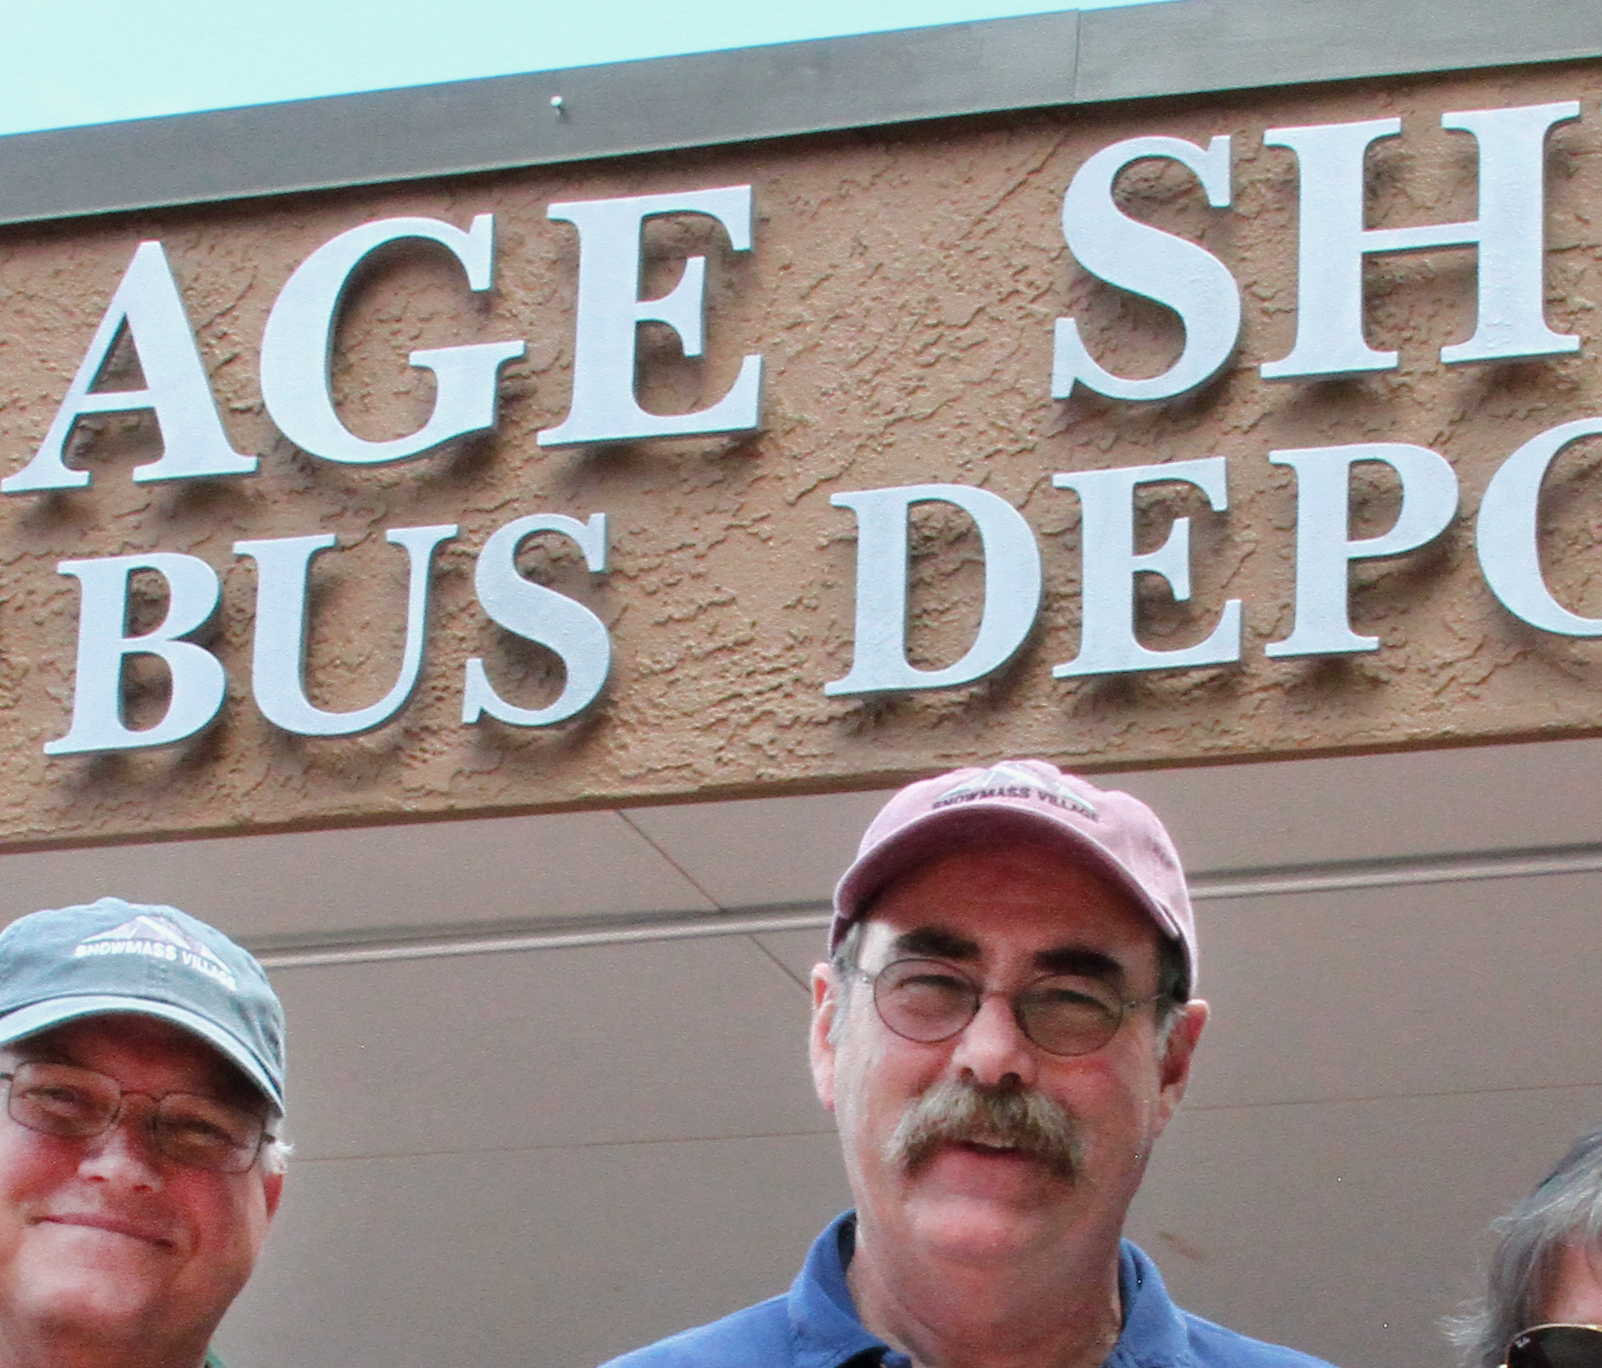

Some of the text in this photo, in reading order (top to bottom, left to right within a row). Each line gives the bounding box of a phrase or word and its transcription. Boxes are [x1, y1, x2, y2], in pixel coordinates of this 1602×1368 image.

[43, 511, 617, 757] BUS
[932, 785, 1031, 810] SNOWMASS
[74, 940, 178, 961] SNOWMASS
